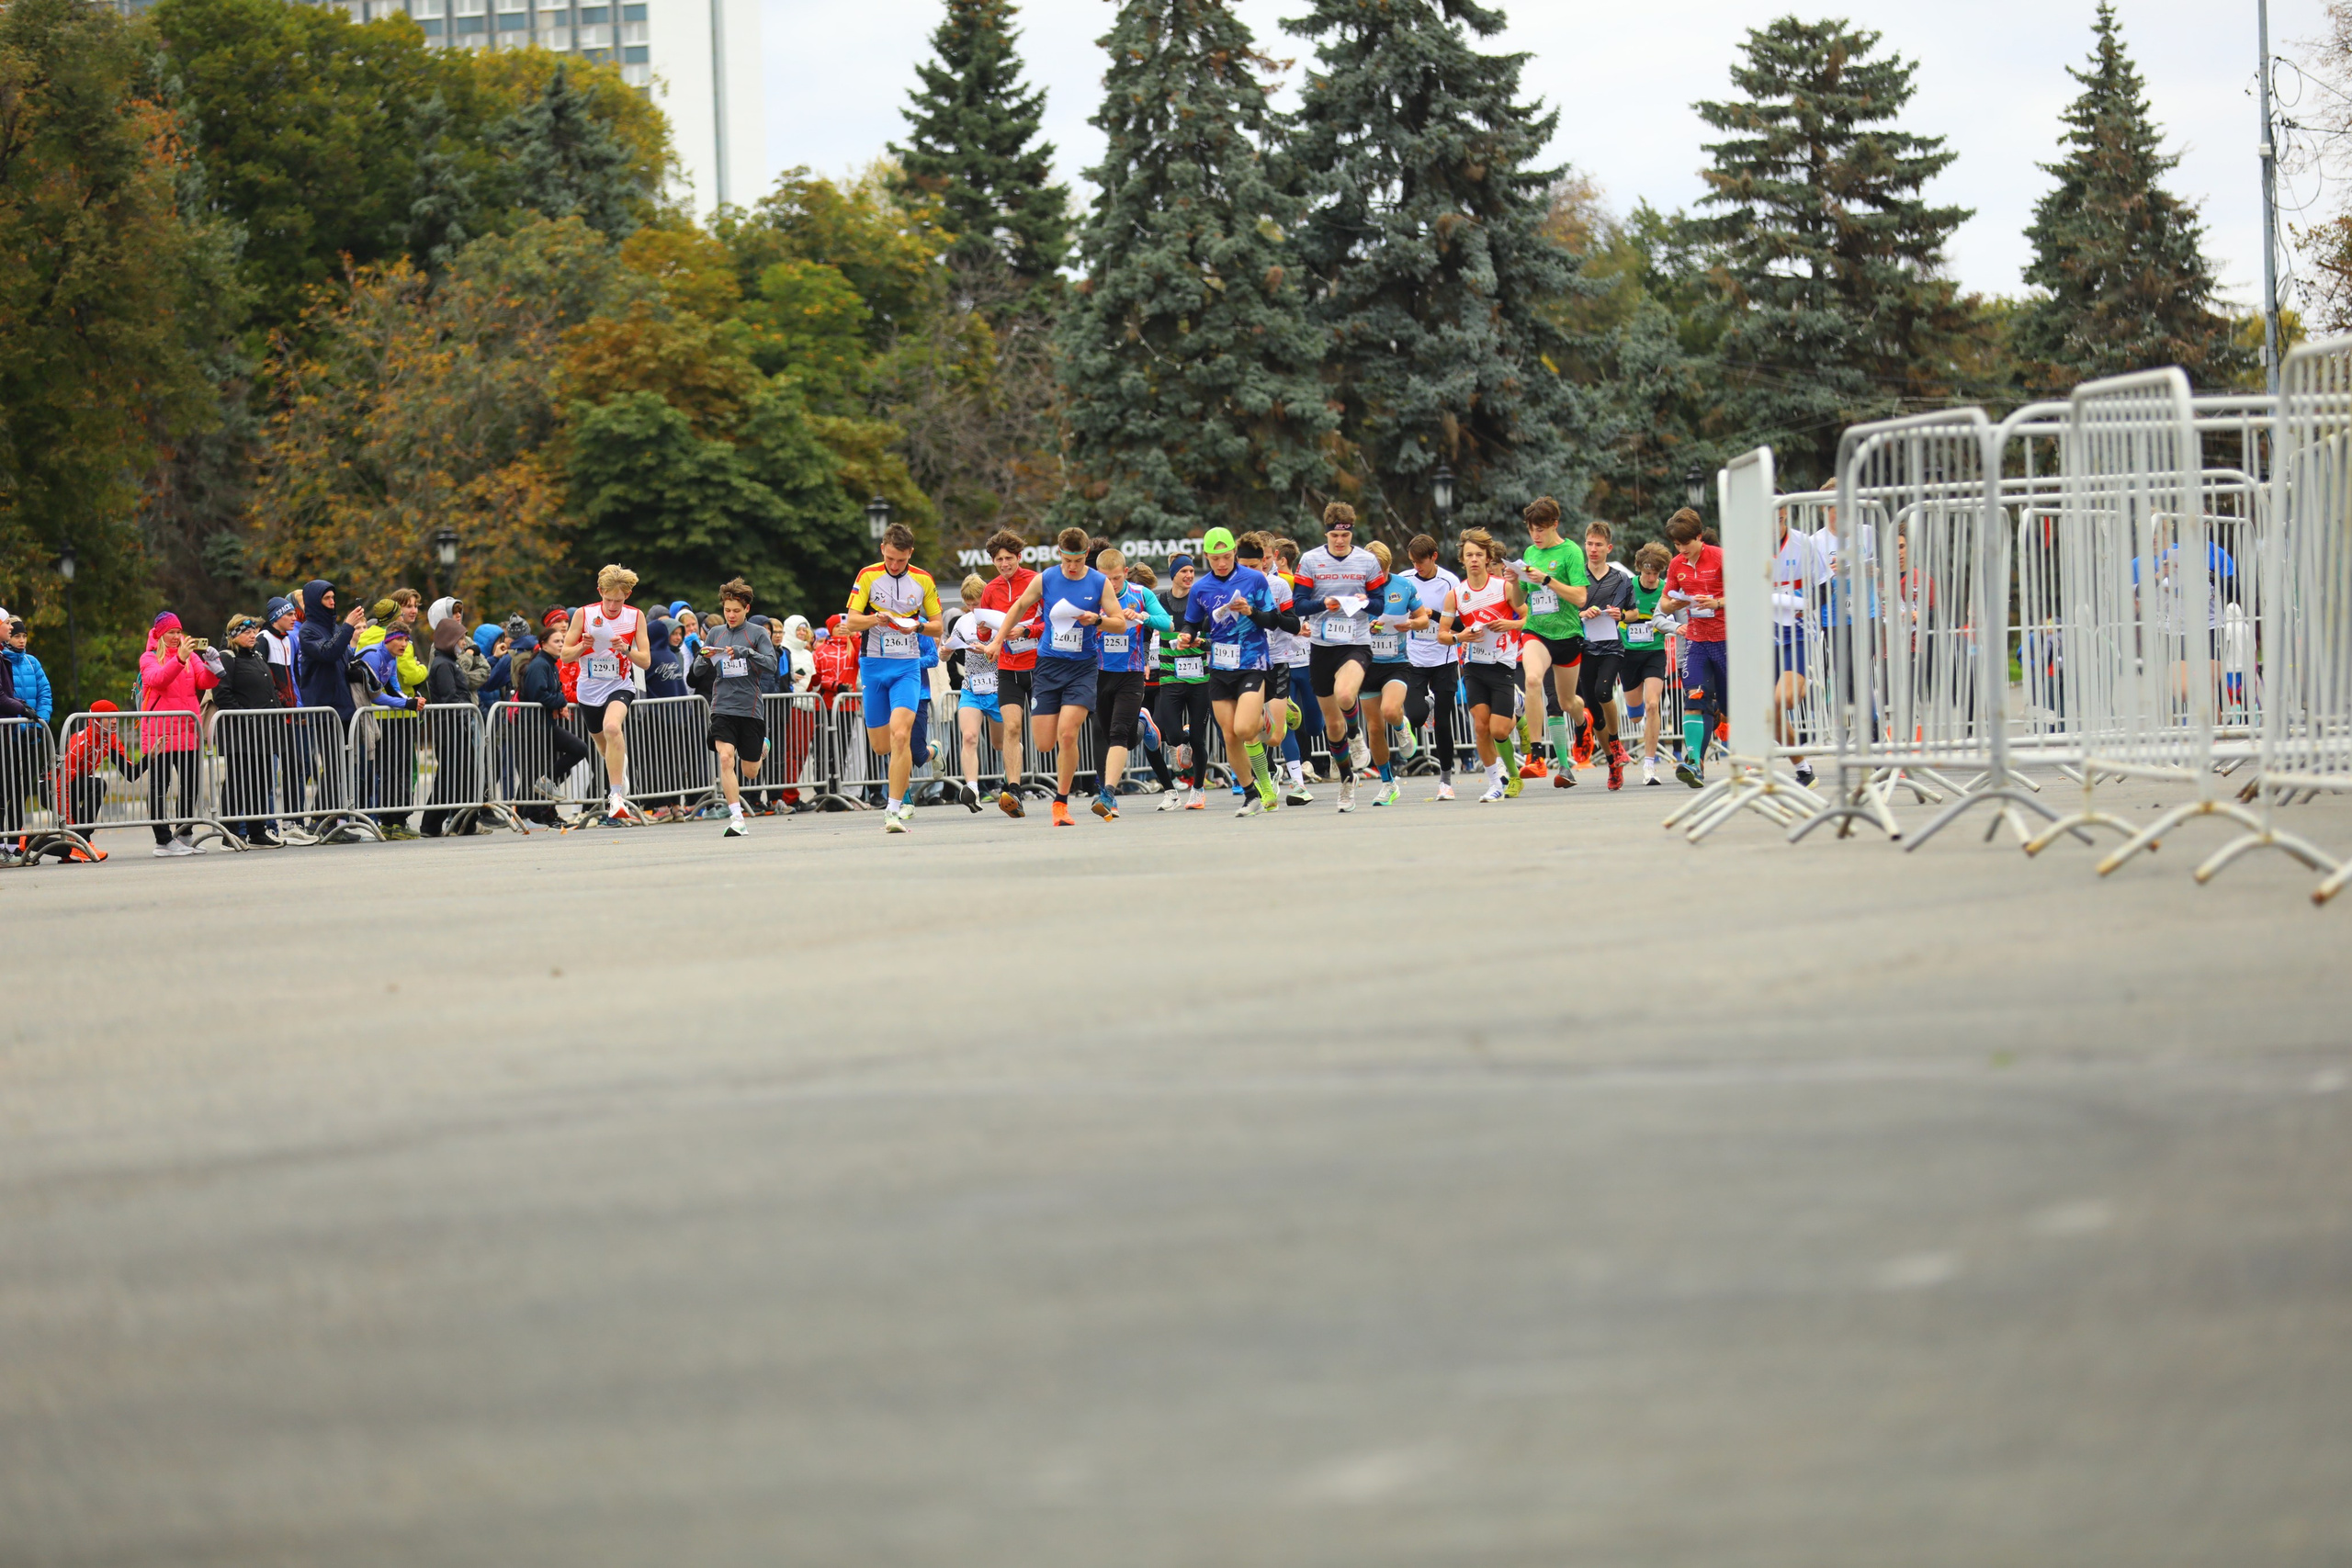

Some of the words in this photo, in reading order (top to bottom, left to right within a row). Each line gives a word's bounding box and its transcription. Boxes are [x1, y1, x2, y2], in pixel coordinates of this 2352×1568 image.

[1121, 538, 1204, 558] ОБЛАСТ
[1478, 611, 1491, 621] Run
[1327, 623, 1351, 633] 210.1
[1629, 626, 1648, 635] 221.1
[885, 637, 908, 647] 236.1
[1105, 637, 1127, 647] 225.1
[1372, 640, 1393, 649] 211.1
[1215, 647, 1234, 658] 219.1
[1472, 646, 1490, 656] 209.
[594, 663, 616, 671] 229.1
[1178, 662, 1198, 671] 227.1
[973, 677, 991, 687] 233.1
